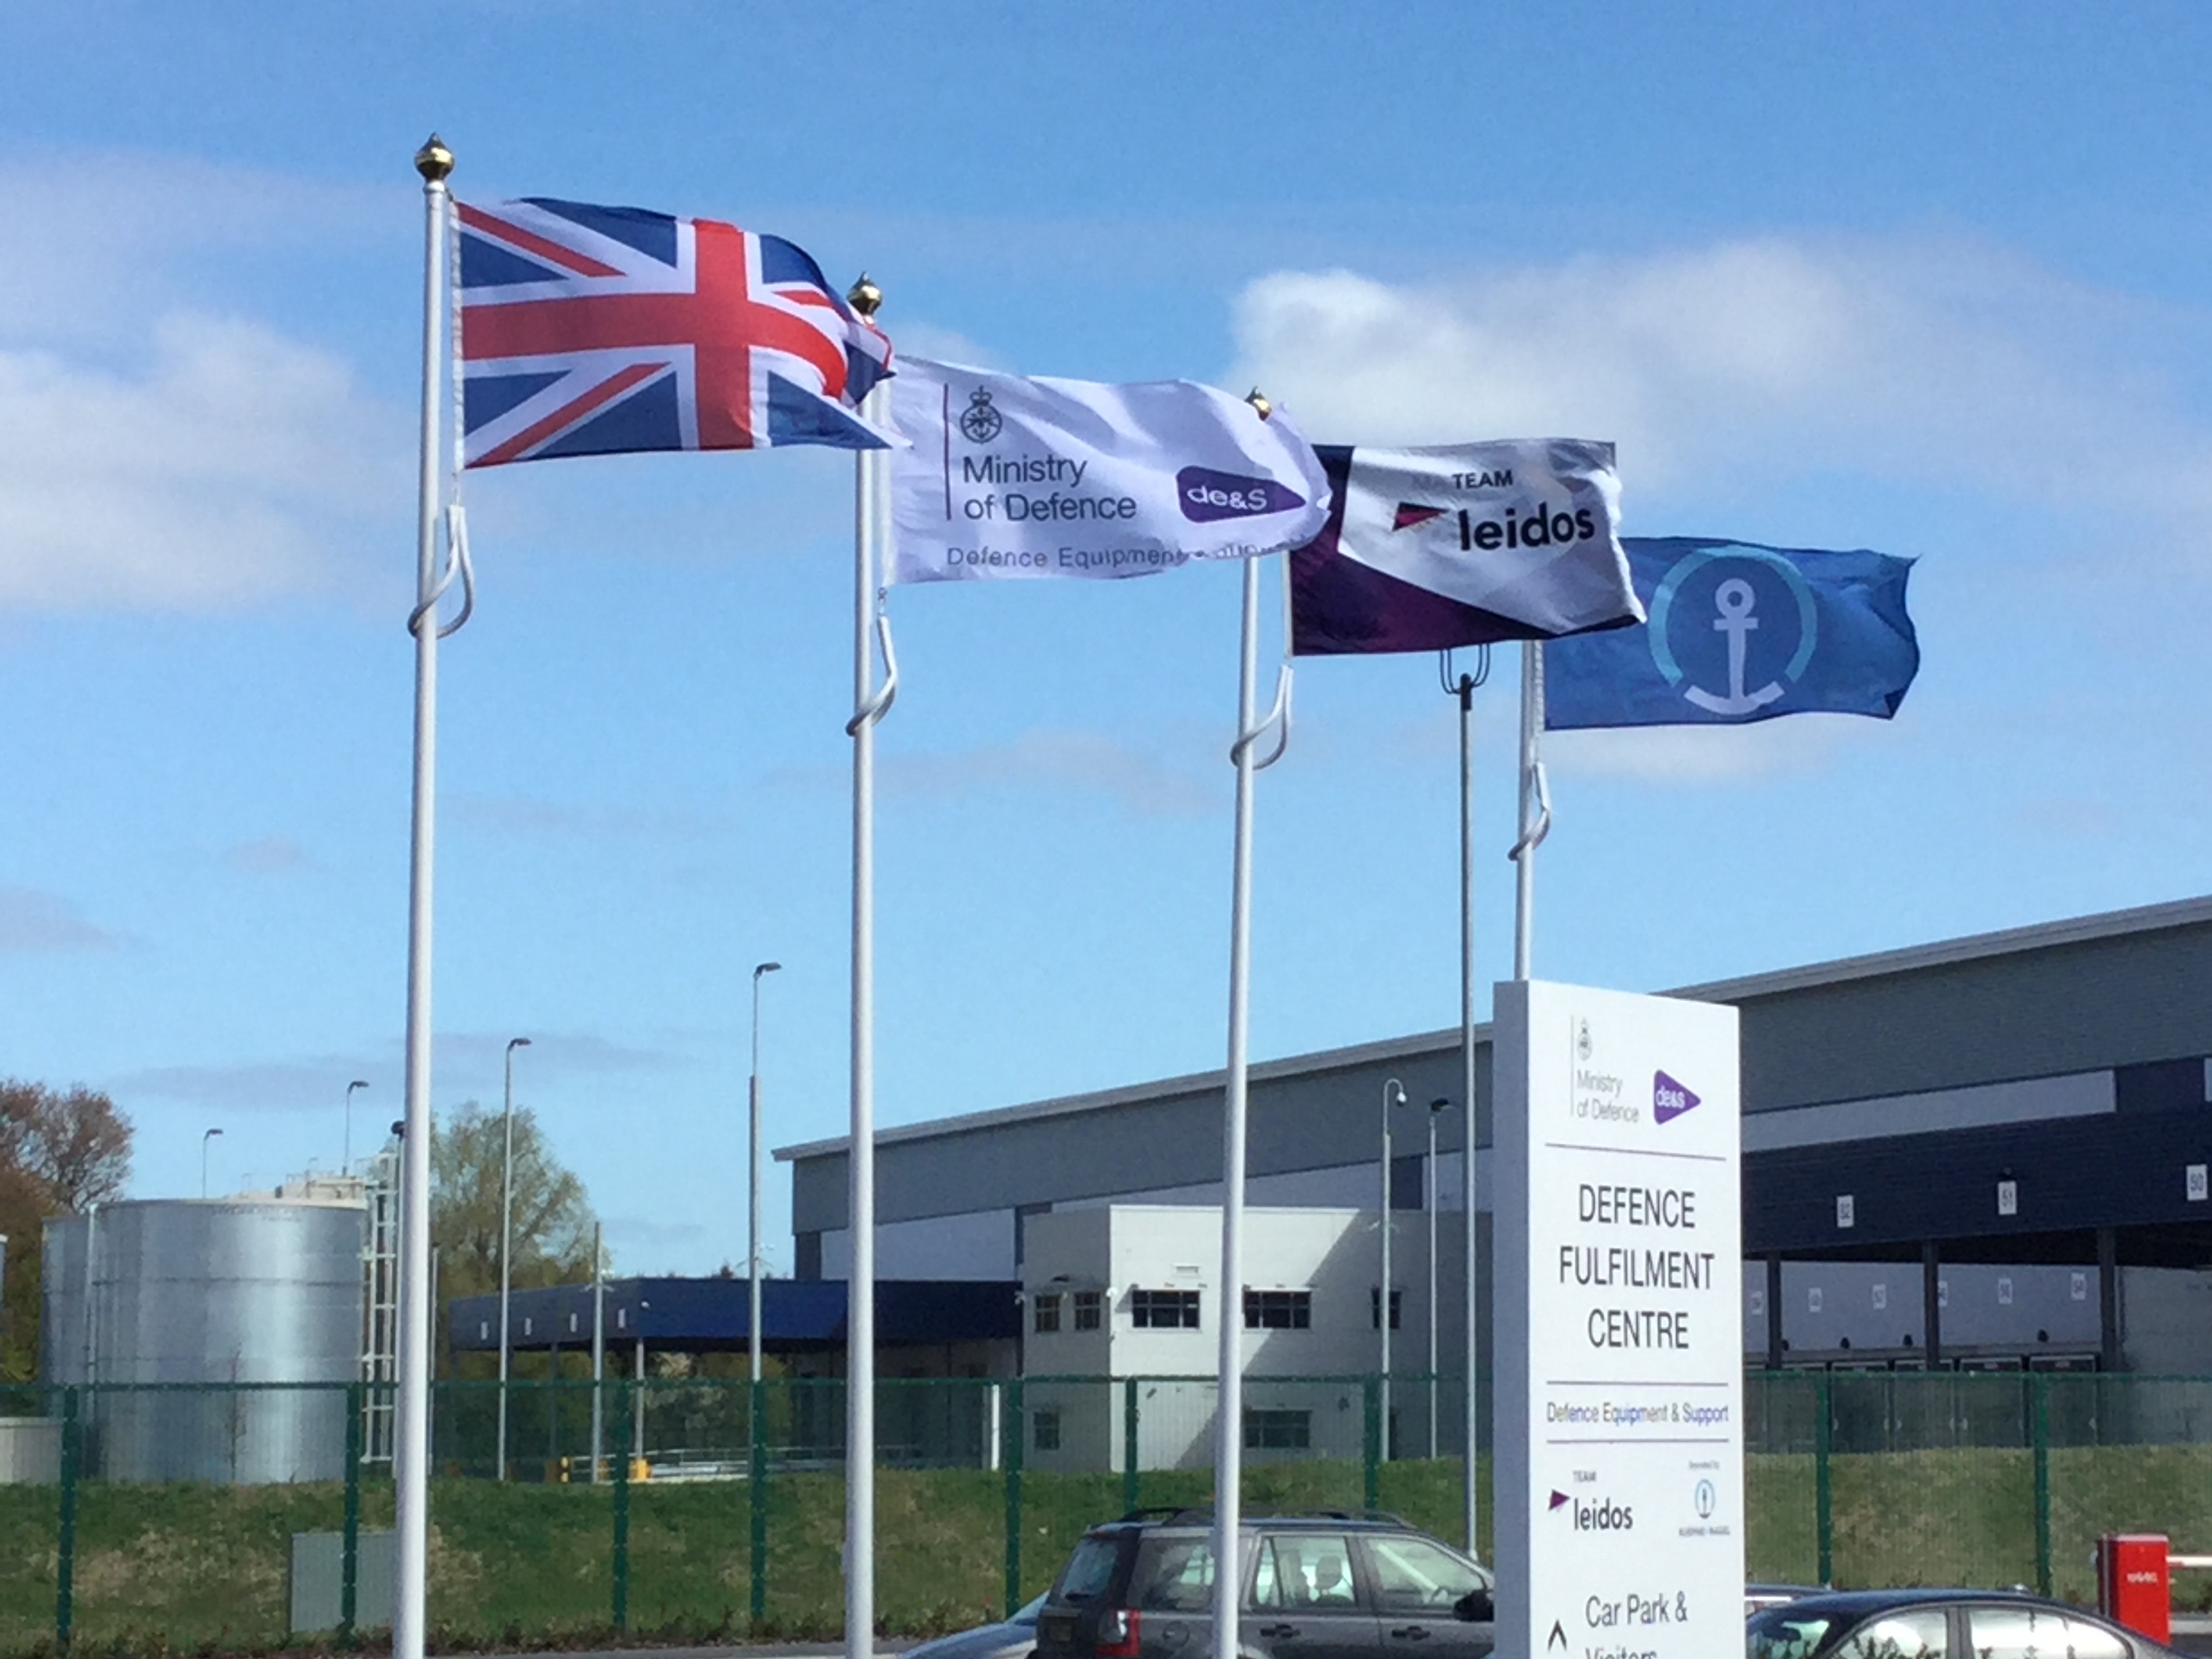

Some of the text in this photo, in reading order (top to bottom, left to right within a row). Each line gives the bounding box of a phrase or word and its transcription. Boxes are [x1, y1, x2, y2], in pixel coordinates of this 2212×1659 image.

[963, 455, 1086, 487] Ministry
[1453, 470, 1513, 489] TEAM
[964, 493, 1137, 521] of Defence
[1458, 501, 1595, 550] leidos
[947, 548, 1047, 567] Defence
[1576, 1069, 1622, 1097] Ministry
[1579, 1184, 1695, 1228] DEFENCE
[1560, 1246, 1715, 1289] FULFILMENT
[1588, 1309, 1689, 1349] CENTRE
[1547, 1401, 1729, 1426] Defence Equipment & Support
[1574, 1496, 1633, 1530] leidos
[1586, 1591, 1687, 1628] Car Park &
